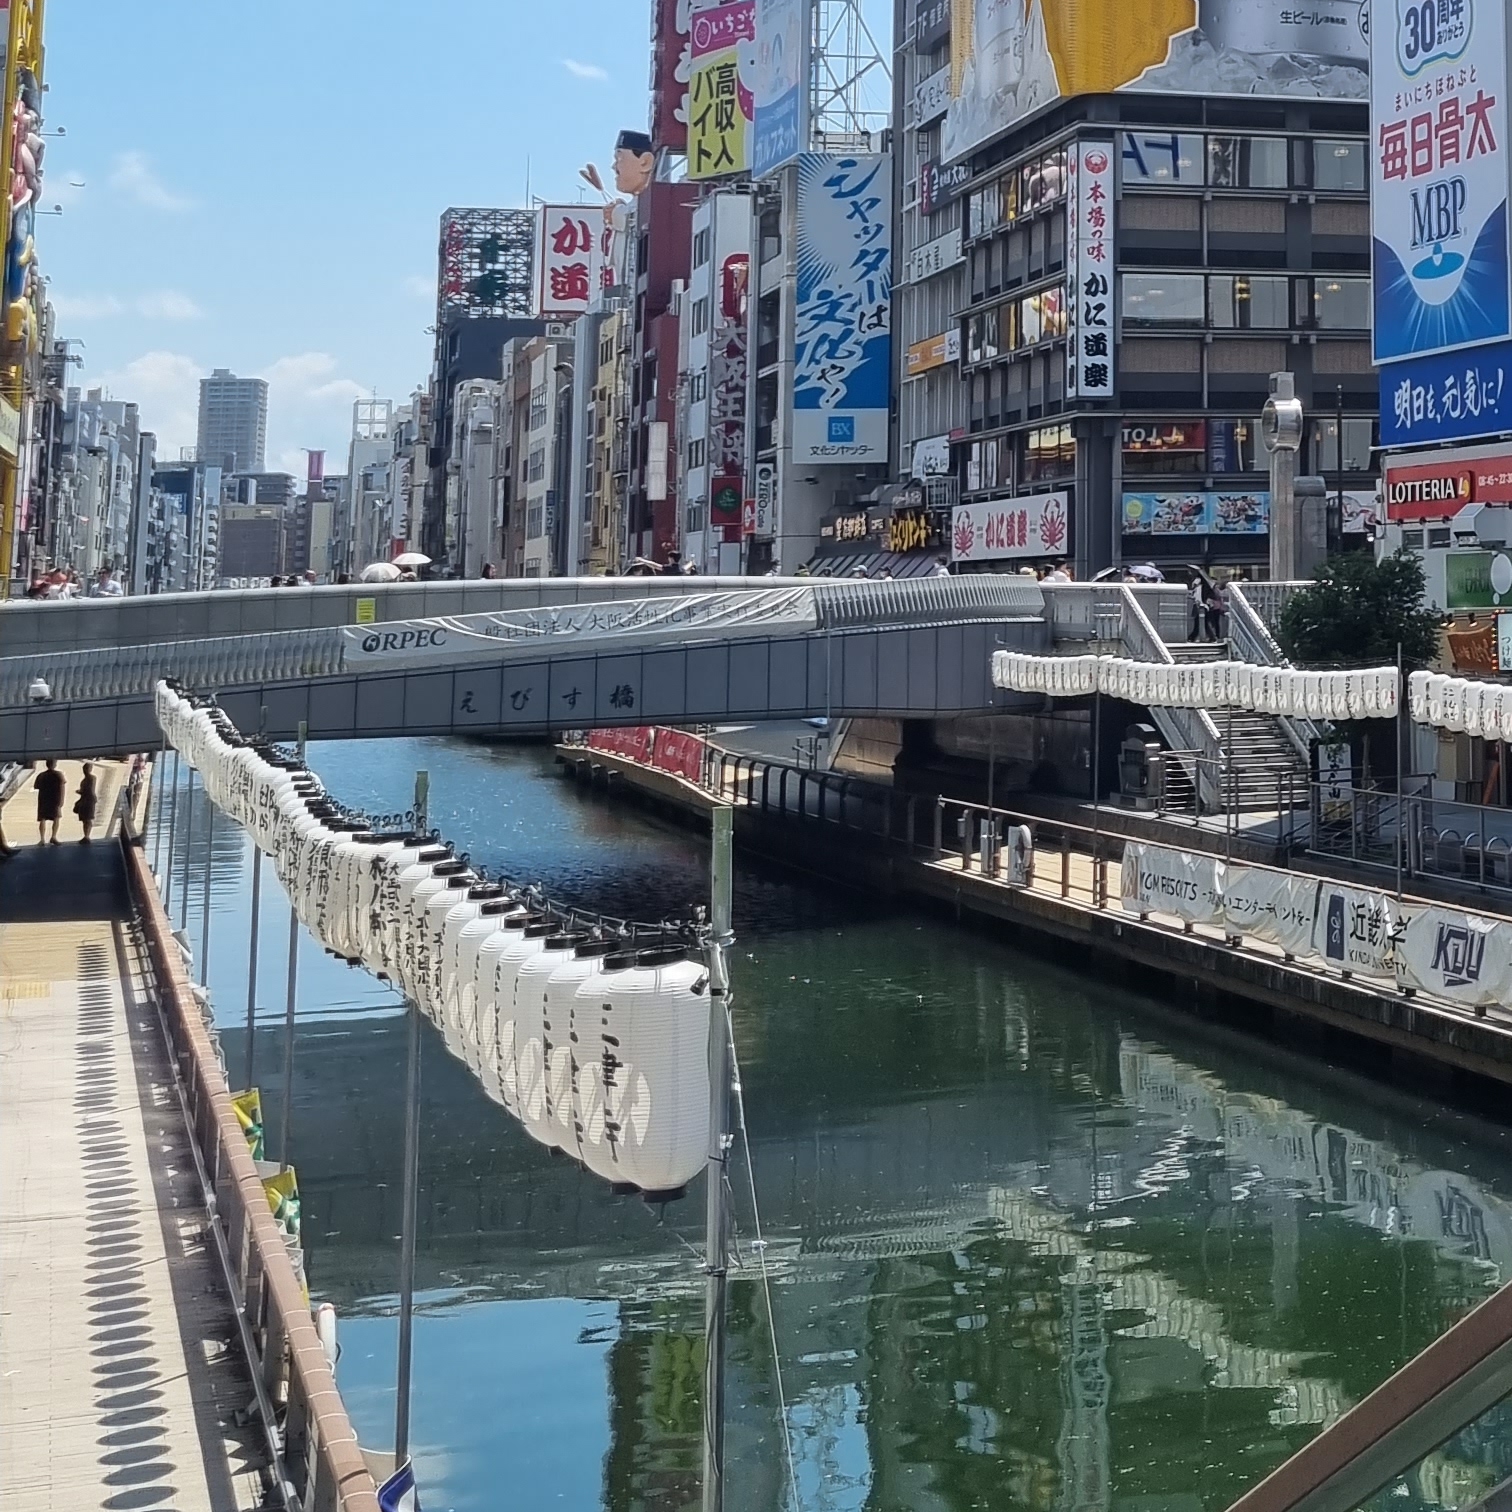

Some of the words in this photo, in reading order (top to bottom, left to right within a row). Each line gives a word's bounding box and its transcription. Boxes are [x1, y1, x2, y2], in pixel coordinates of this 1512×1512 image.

[1280, 10, 1322, 26] 生ビール
[1437, 22, 1464, 45] ありがとう
[693, 65, 715, 172] バイト
[714, 62, 737, 169] 高収入
[1395, 64, 1477, 112] まいにちほねぶと
[1379, 89, 1497, 181] 毎日骨太
[1086, 180, 1106, 263] 本場の味
[1411, 175, 1467, 250] MBP
[823, 158, 889, 334] シャッターは
[832, 422, 851, 436] BX
[1389, 477, 1455, 504] LOTTERIA
[460, 684, 635, 713] えびす橋
